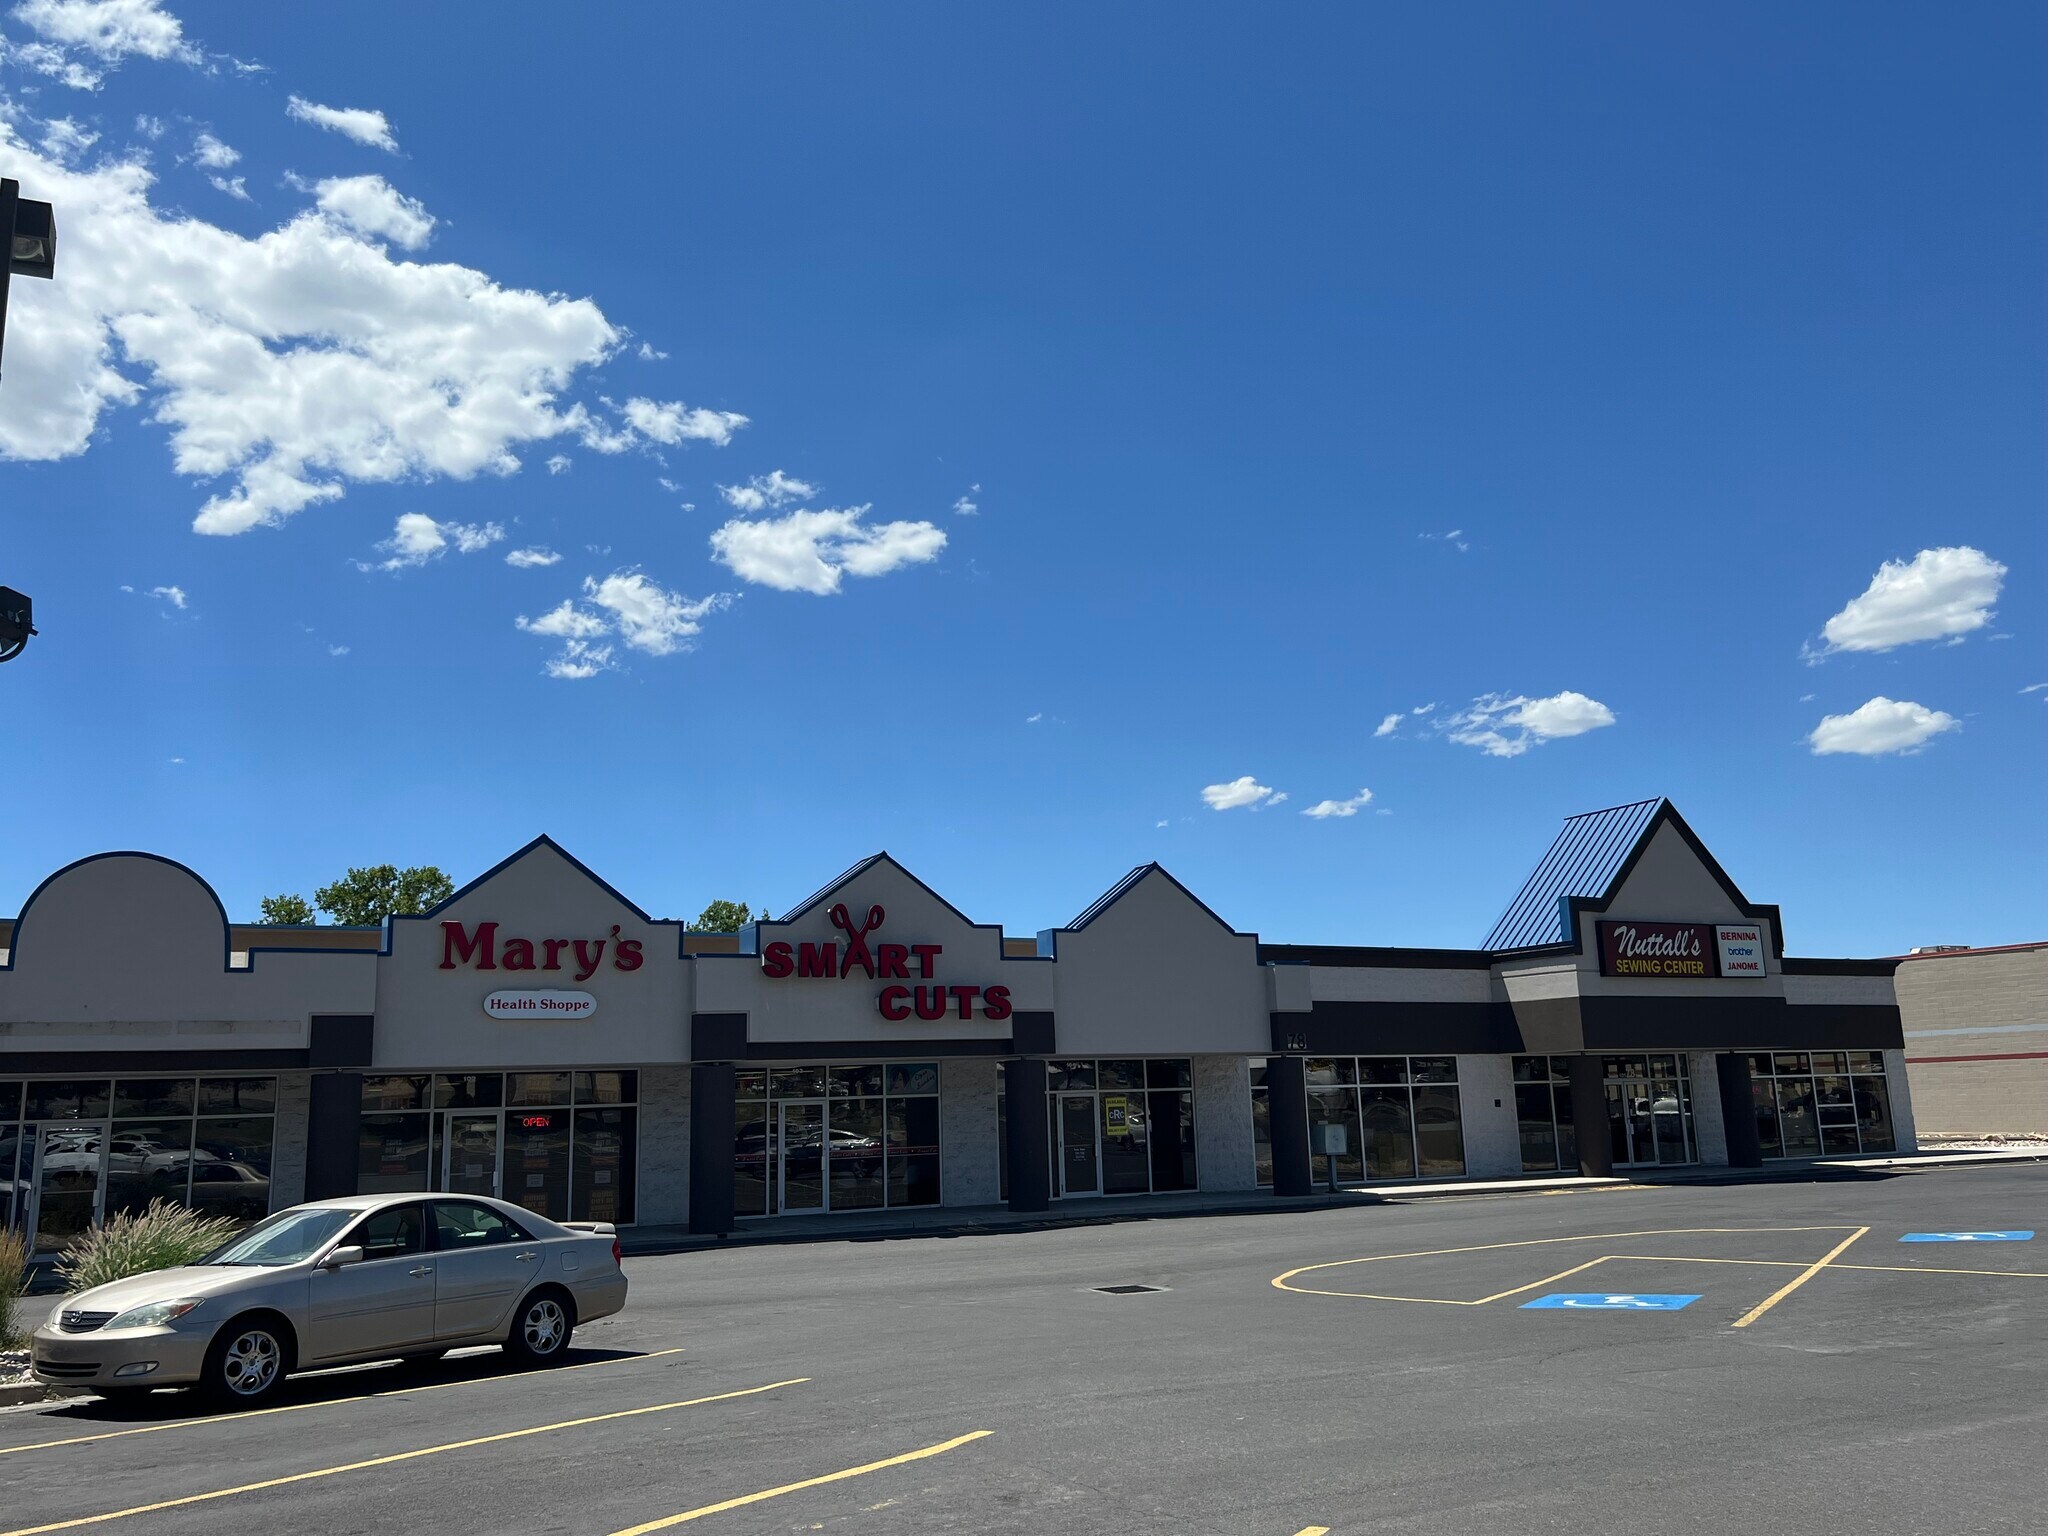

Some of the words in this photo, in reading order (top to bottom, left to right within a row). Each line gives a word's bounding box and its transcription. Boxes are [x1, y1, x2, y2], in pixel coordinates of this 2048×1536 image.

[1613, 925, 1702, 957] Nuttall's
[1720, 932, 1757, 941] BERNINA
[439, 921, 644, 981] Mary's
[1728, 947, 1753, 956] brother
[1616, 959, 1661, 973] SEWING
[1663, 960, 1704, 974] CENTER
[1728, 962, 1759, 970] JANOME
[490, 999, 536, 1010] Health
[540, 999, 590, 1012] Shoppe
[878, 985, 1013, 1021] CUTS
[1287, 1033, 1305, 1048] 78
[522, 1117, 550, 1127] OPEN
